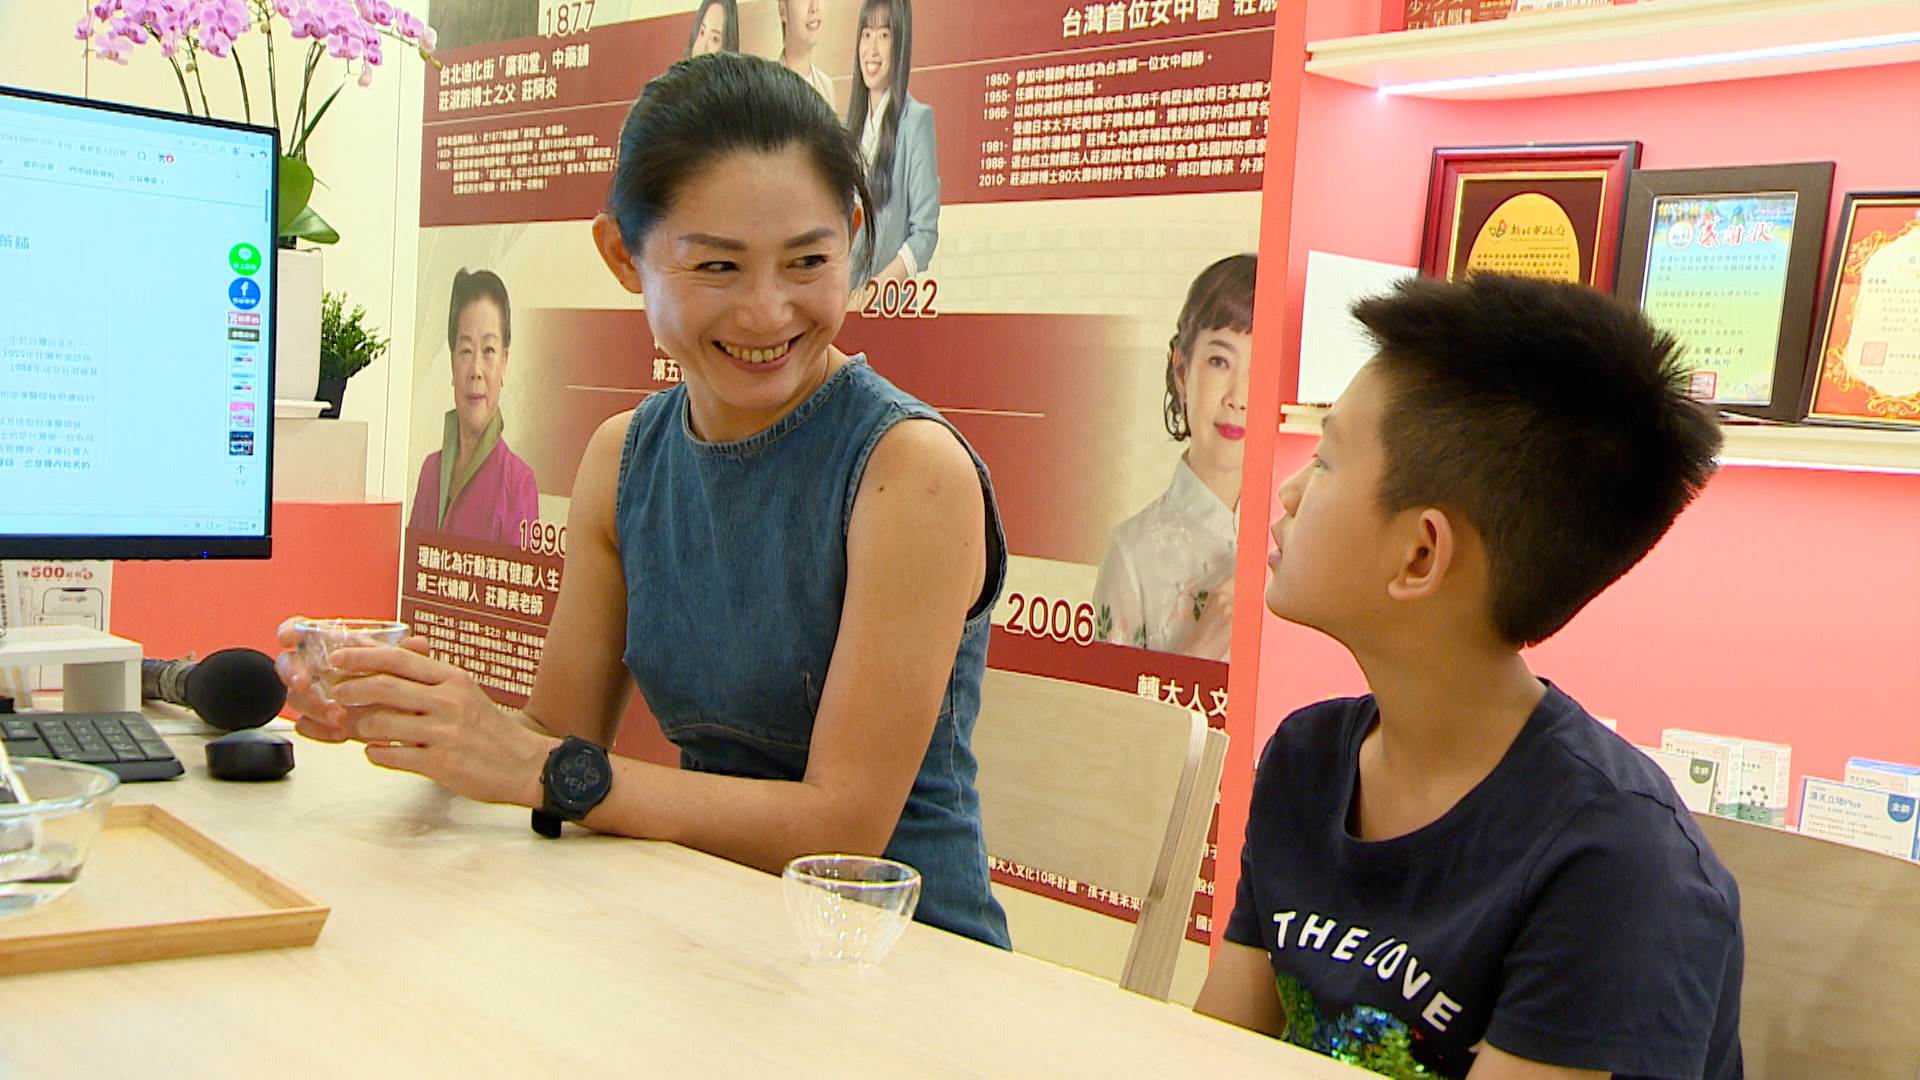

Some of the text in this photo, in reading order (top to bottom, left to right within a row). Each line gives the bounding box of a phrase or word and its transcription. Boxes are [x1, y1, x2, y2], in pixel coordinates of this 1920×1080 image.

[546, 1, 594, 38] 1877
[1062, 0, 1219, 38] 台灣首位女中醫
[521, 76, 557, 102] 莊阿炎
[861, 279, 938, 319] 2022
[652, 358, 686, 382] 第五
[1005, 591, 1095, 645] 2006
[1273, 911, 1463, 1033] THE LOVE
